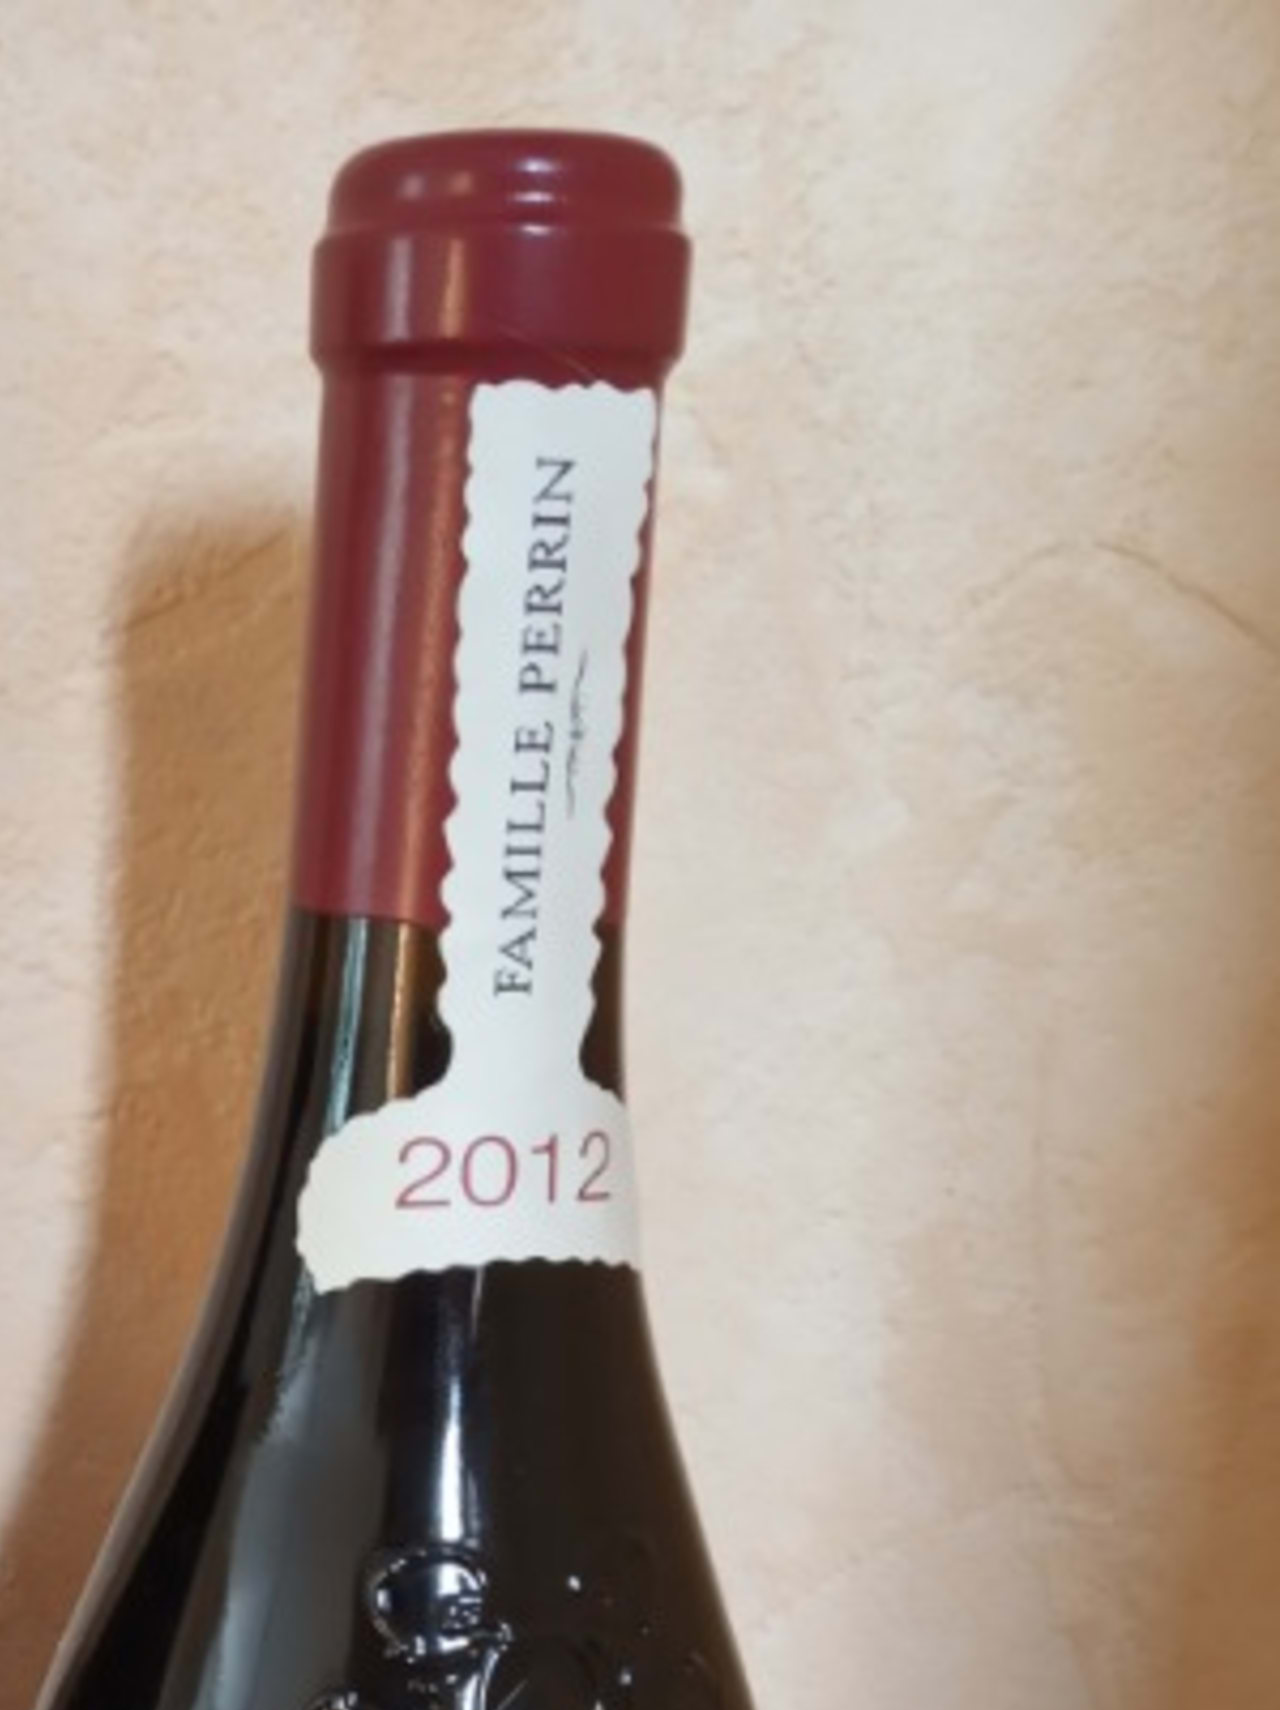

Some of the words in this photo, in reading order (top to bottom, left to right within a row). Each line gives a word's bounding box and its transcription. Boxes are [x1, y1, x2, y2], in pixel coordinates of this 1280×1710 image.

[517, 455, 577, 696] PERRIN
[493, 720, 556, 997] FAMILLE
[393, 1129, 612, 1210] 2012
